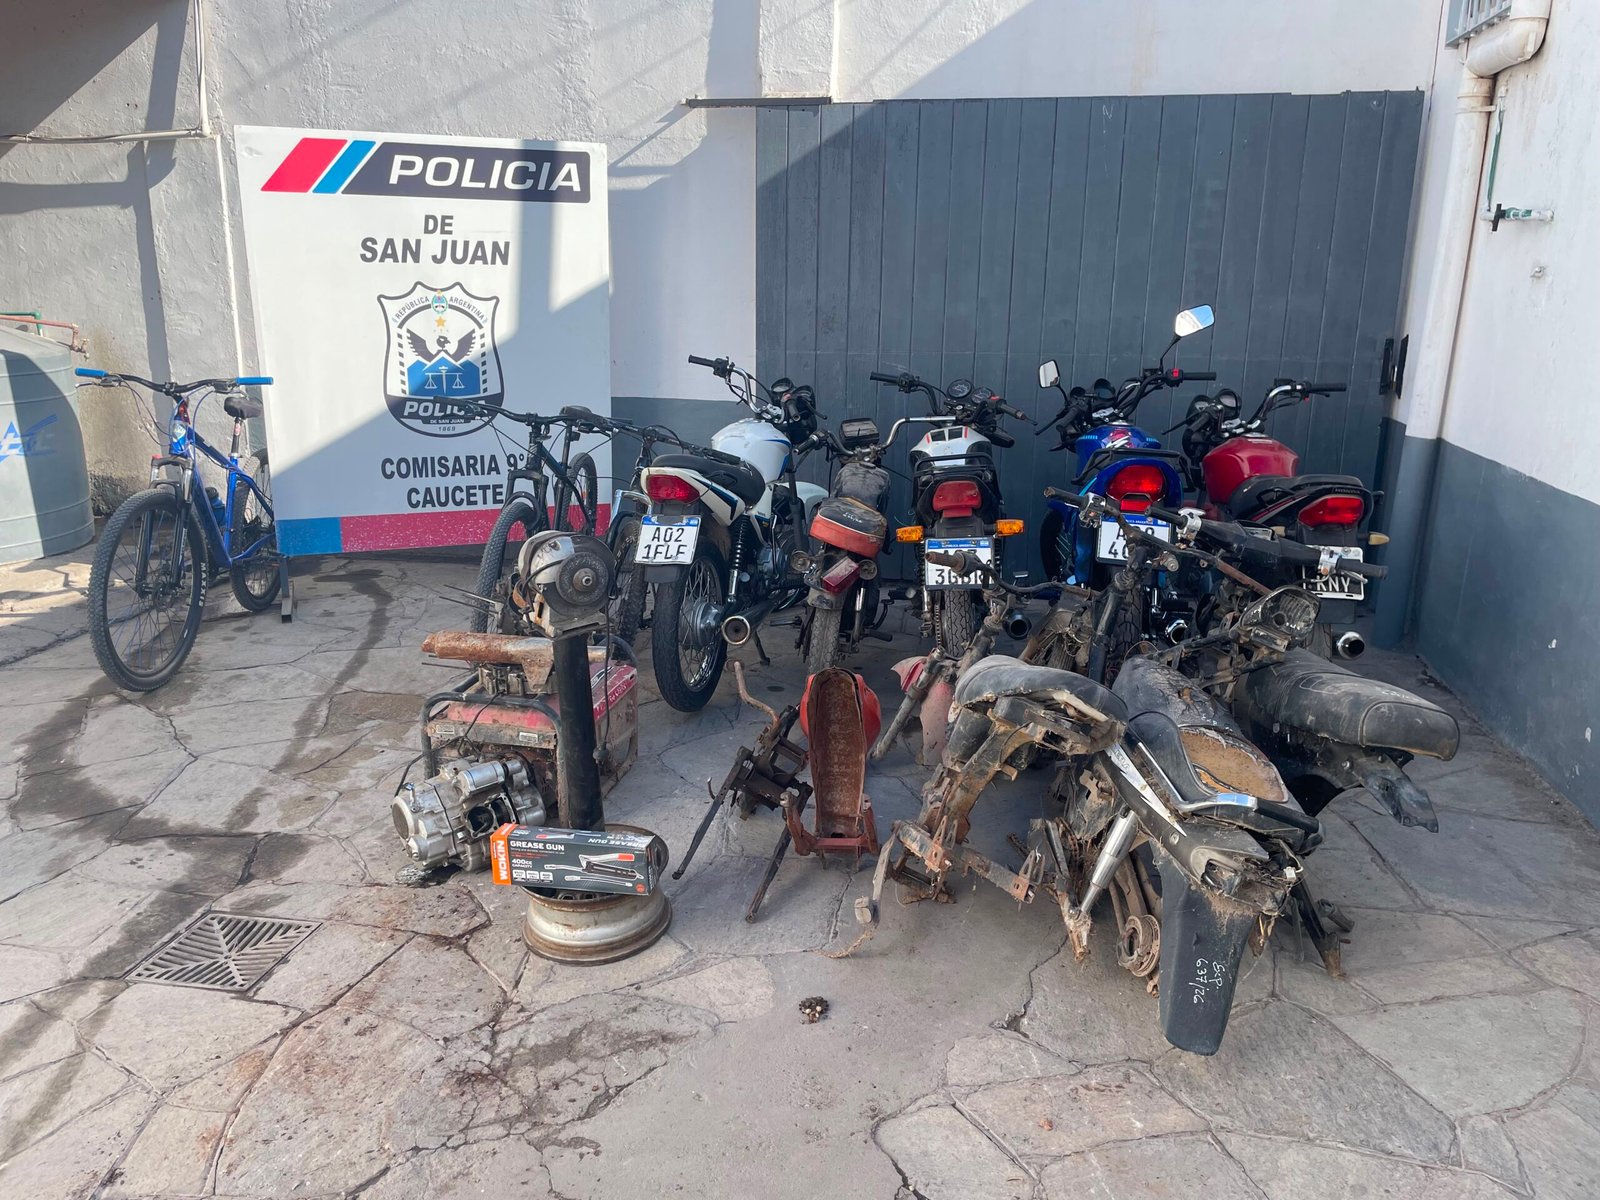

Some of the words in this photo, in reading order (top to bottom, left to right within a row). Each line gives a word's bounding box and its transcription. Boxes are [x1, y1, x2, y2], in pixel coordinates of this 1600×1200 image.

[389, 154, 582, 192] POLICIA
[423, 214, 454, 236] DE
[359, 237, 422, 264] SAN
[431, 239, 511, 266] JUAN
[449, 296, 485, 321] ARGENTINA
[381, 454, 501, 480] COMISARIA
[406, 483, 504, 509] CAUCETE
[510, 840, 544, 849] GREASE
[546, 843, 565, 851] GUN
[496, 840, 508, 880] WOKIN
